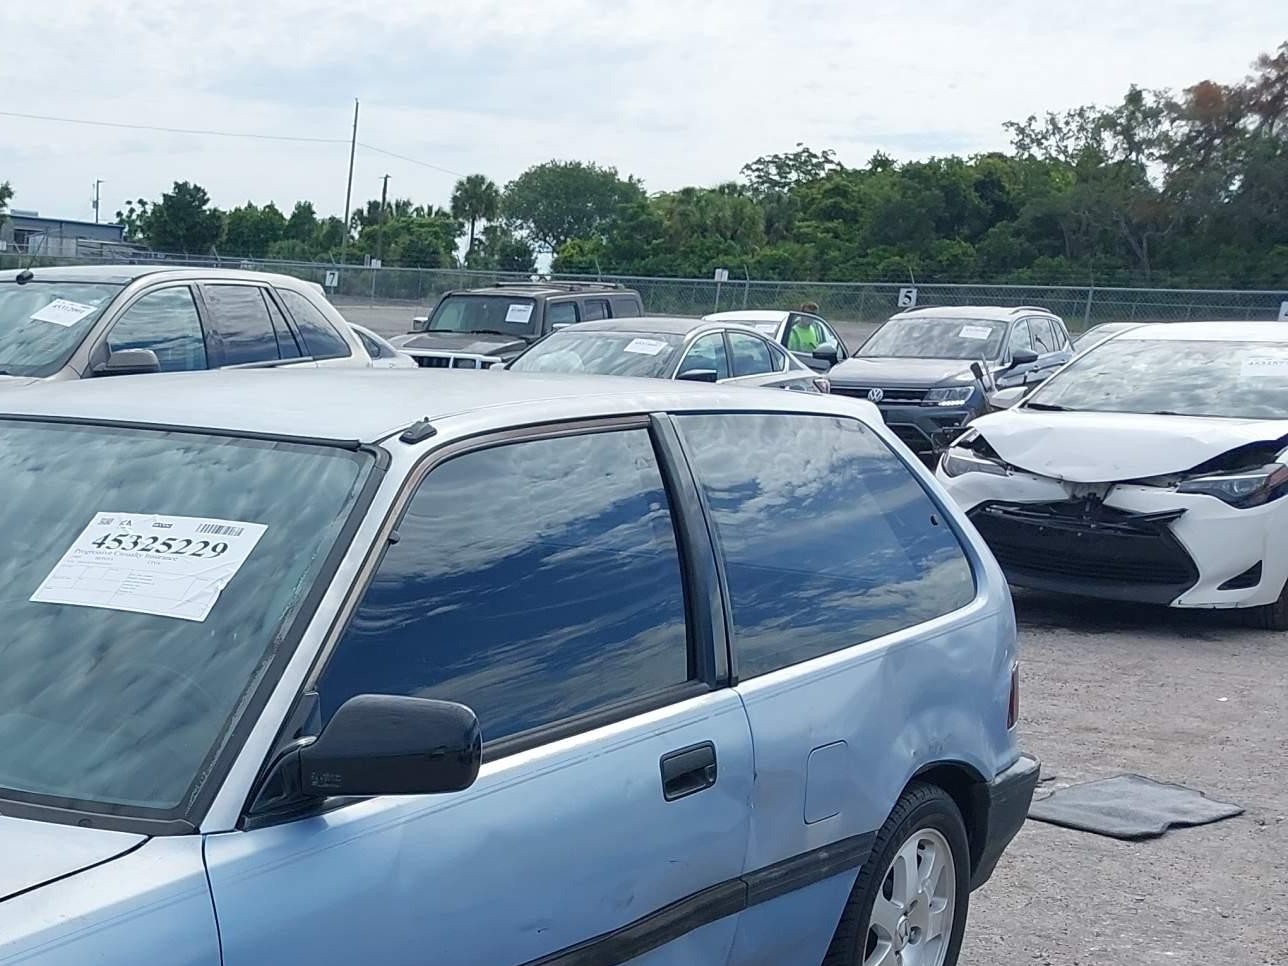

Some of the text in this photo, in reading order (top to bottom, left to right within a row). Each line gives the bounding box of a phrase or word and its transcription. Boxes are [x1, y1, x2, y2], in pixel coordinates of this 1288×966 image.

[329, 272, 336, 285] 7
[902, 290, 913, 305] 5
[92, 533, 229, 559] 45325229
